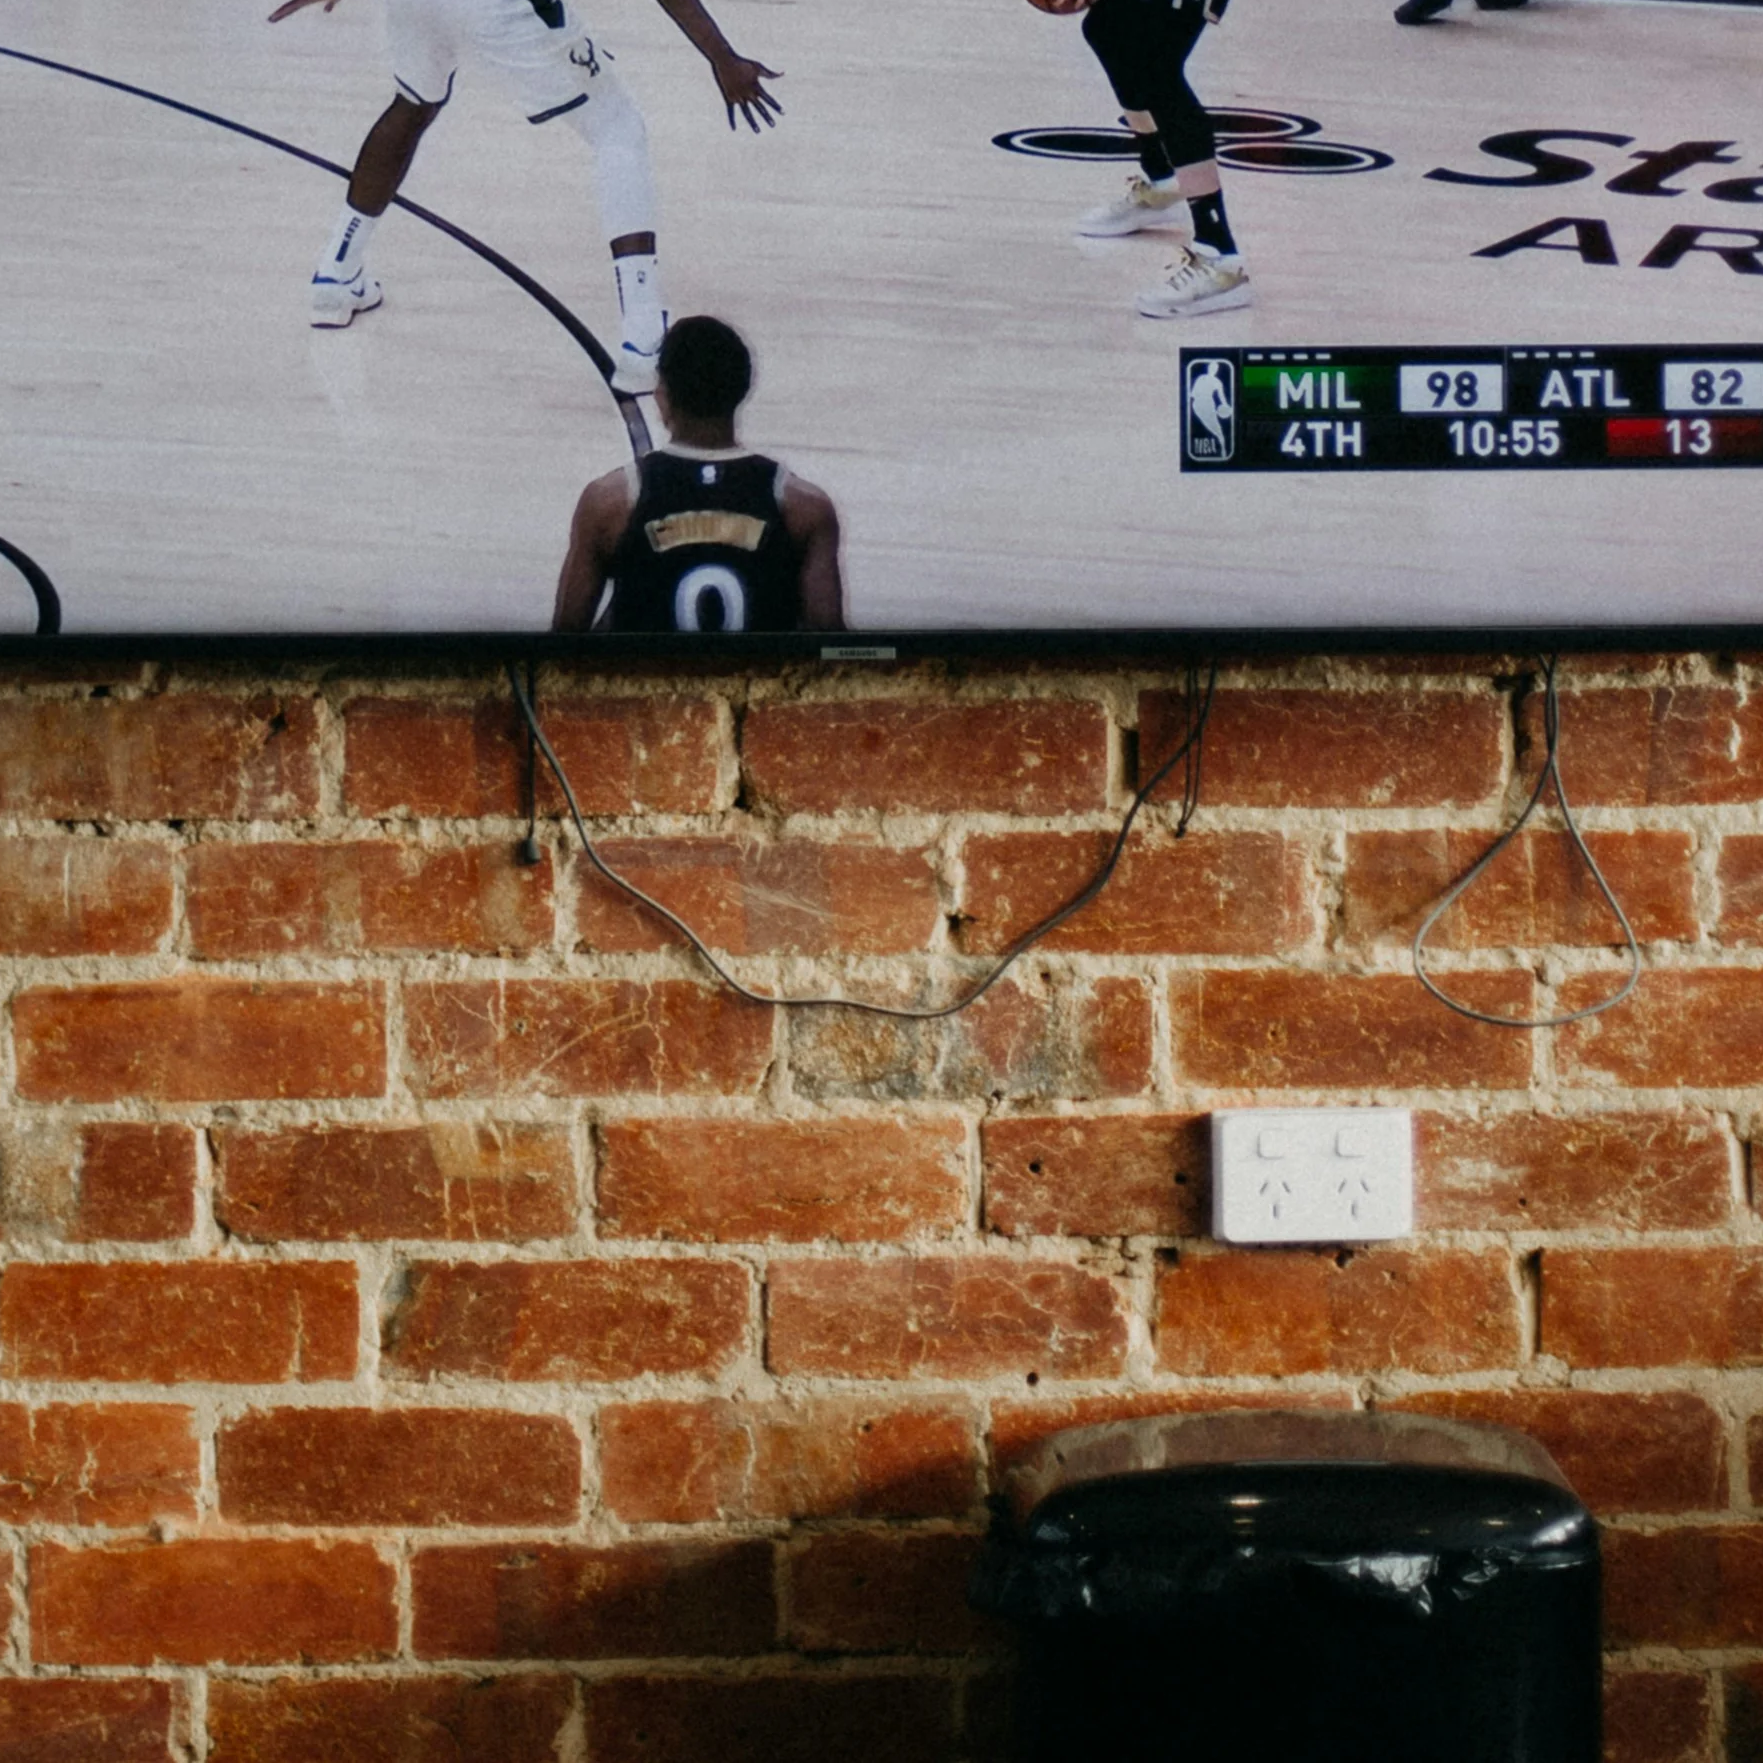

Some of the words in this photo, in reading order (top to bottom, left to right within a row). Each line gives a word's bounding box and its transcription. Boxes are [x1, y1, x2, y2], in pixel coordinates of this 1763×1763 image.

[1279, 372, 1361, 409] MIL
[1427, 371, 1478, 408] 98
[1540, 369, 1631, 407] ATL
[1691, 369, 1744, 406] 82
[1281, 421, 1362, 457] 4TH
[1449, 420, 1560, 457] 10:55
[1666, 419, 1713, 455] 13
[674, 564, 744, 632] 0
